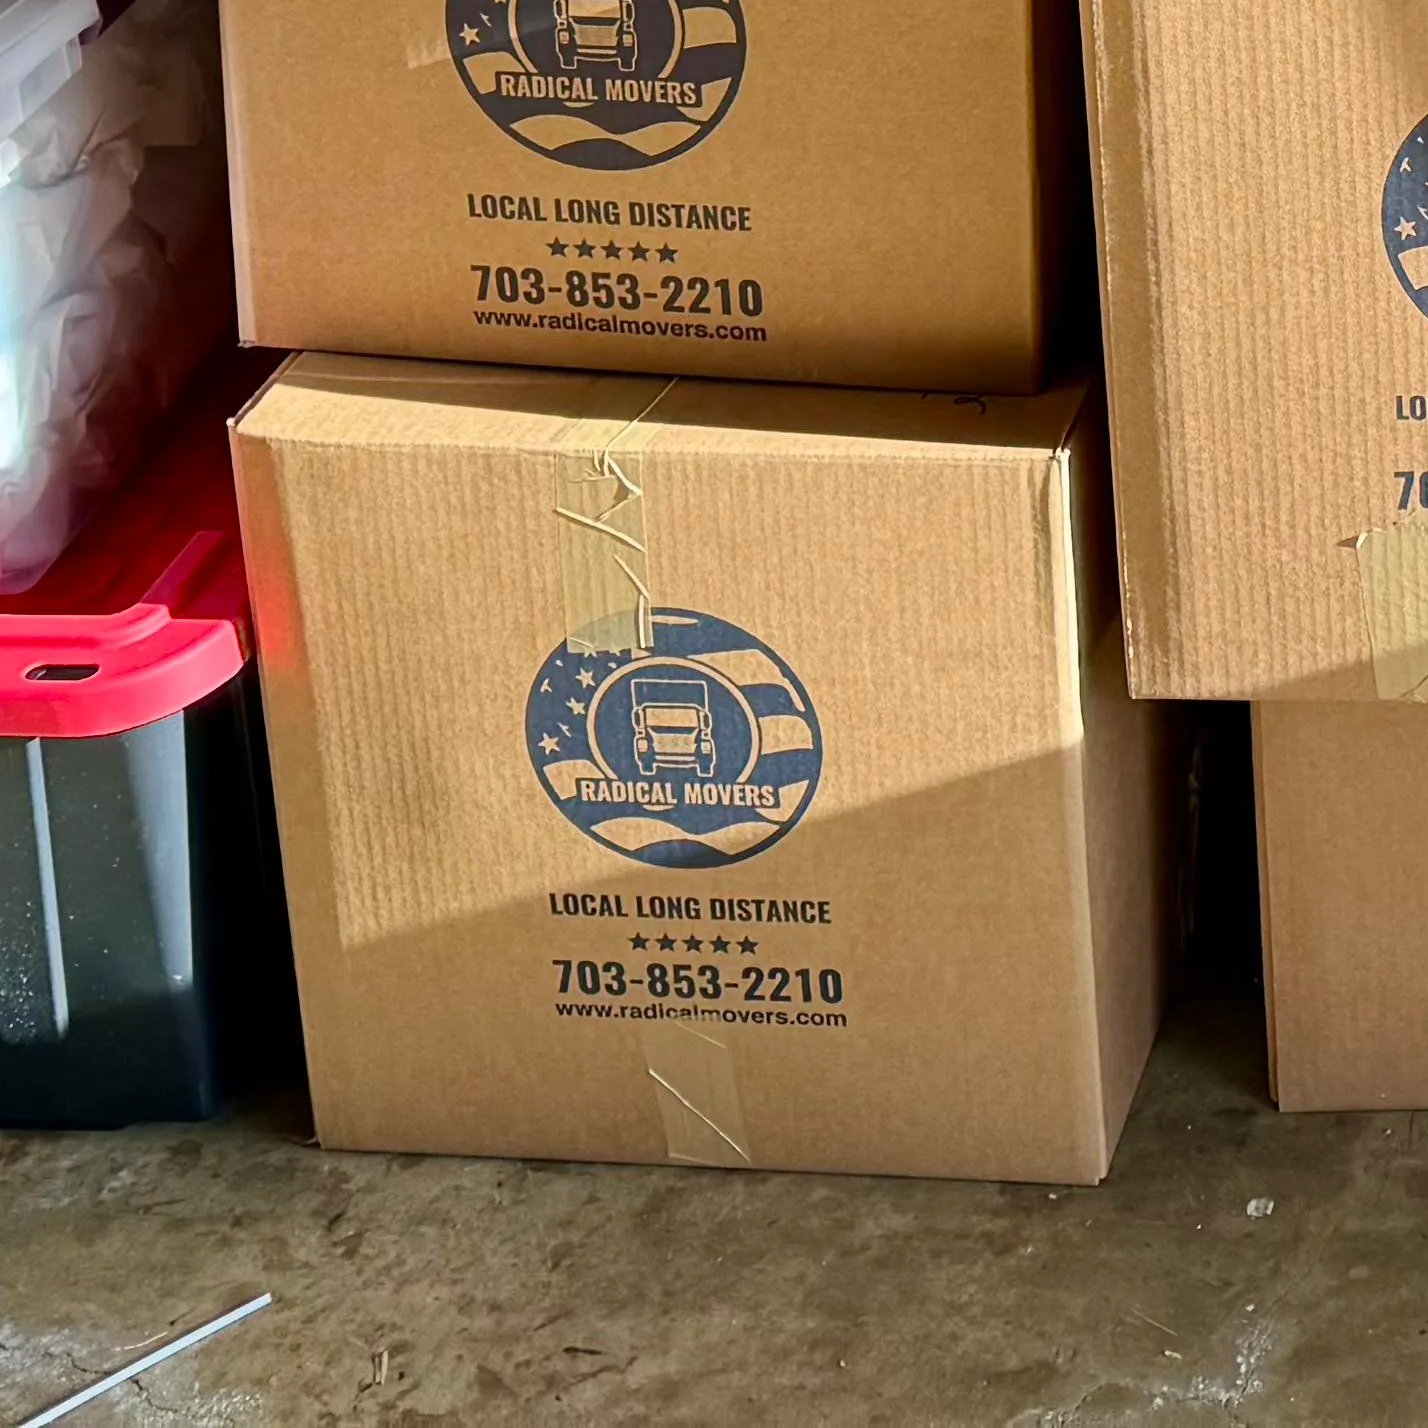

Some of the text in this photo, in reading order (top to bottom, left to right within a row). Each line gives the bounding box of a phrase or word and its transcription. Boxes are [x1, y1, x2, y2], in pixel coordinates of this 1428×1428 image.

[501, 74, 696, 106] RADICAL MOVERS
[467, 193, 752, 232] LOCAL LONG DISTANCE
[470, 264, 763, 317] 703-853-2210
[473, 308, 767, 343] www.radicalmovers.com
[580, 780, 775, 807] RADICAL MOVERS
[549, 893, 831, 924] LOCAL LONG DISTANCE
[552, 960, 842, 1004] 703-853-2210
[555, 1002, 848, 1028] www.radicalmovers.com
